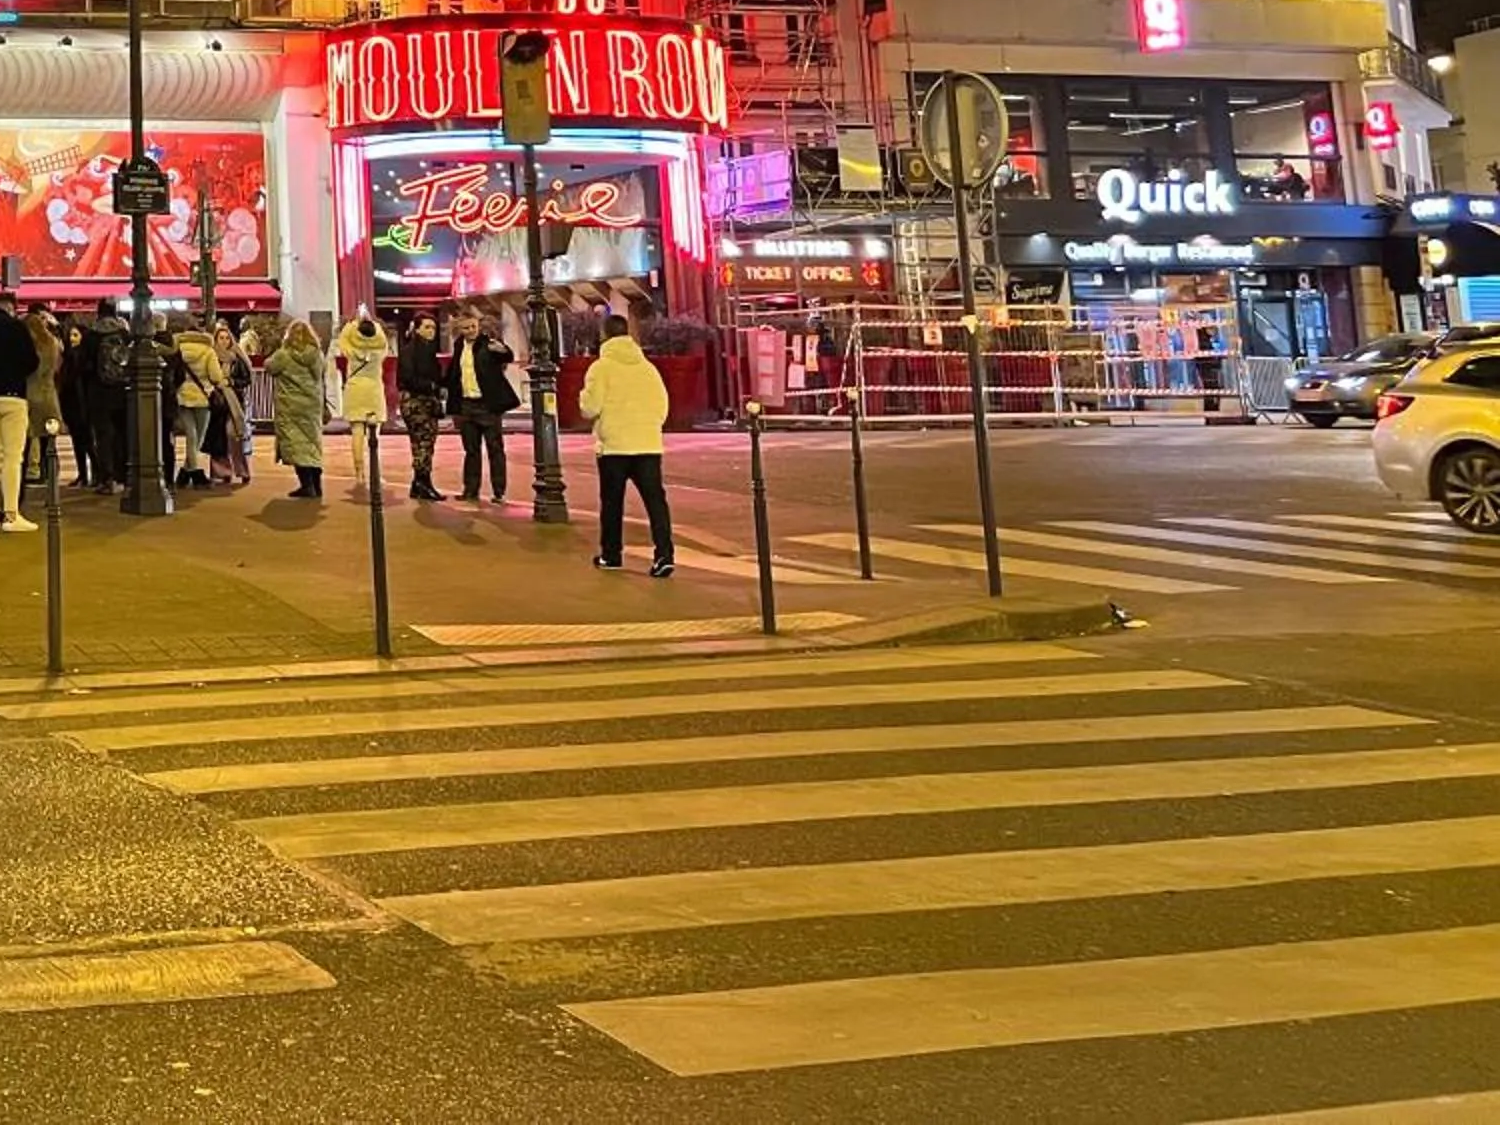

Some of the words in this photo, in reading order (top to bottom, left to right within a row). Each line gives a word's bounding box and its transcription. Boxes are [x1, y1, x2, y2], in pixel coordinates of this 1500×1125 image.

[327, 29, 591, 127] MOULN
[400, 164, 642, 250] Féeie
[1096, 167, 1235, 224] Quick
[745, 266, 792, 282] TICKET
[802, 266, 853, 283] OFFICE
